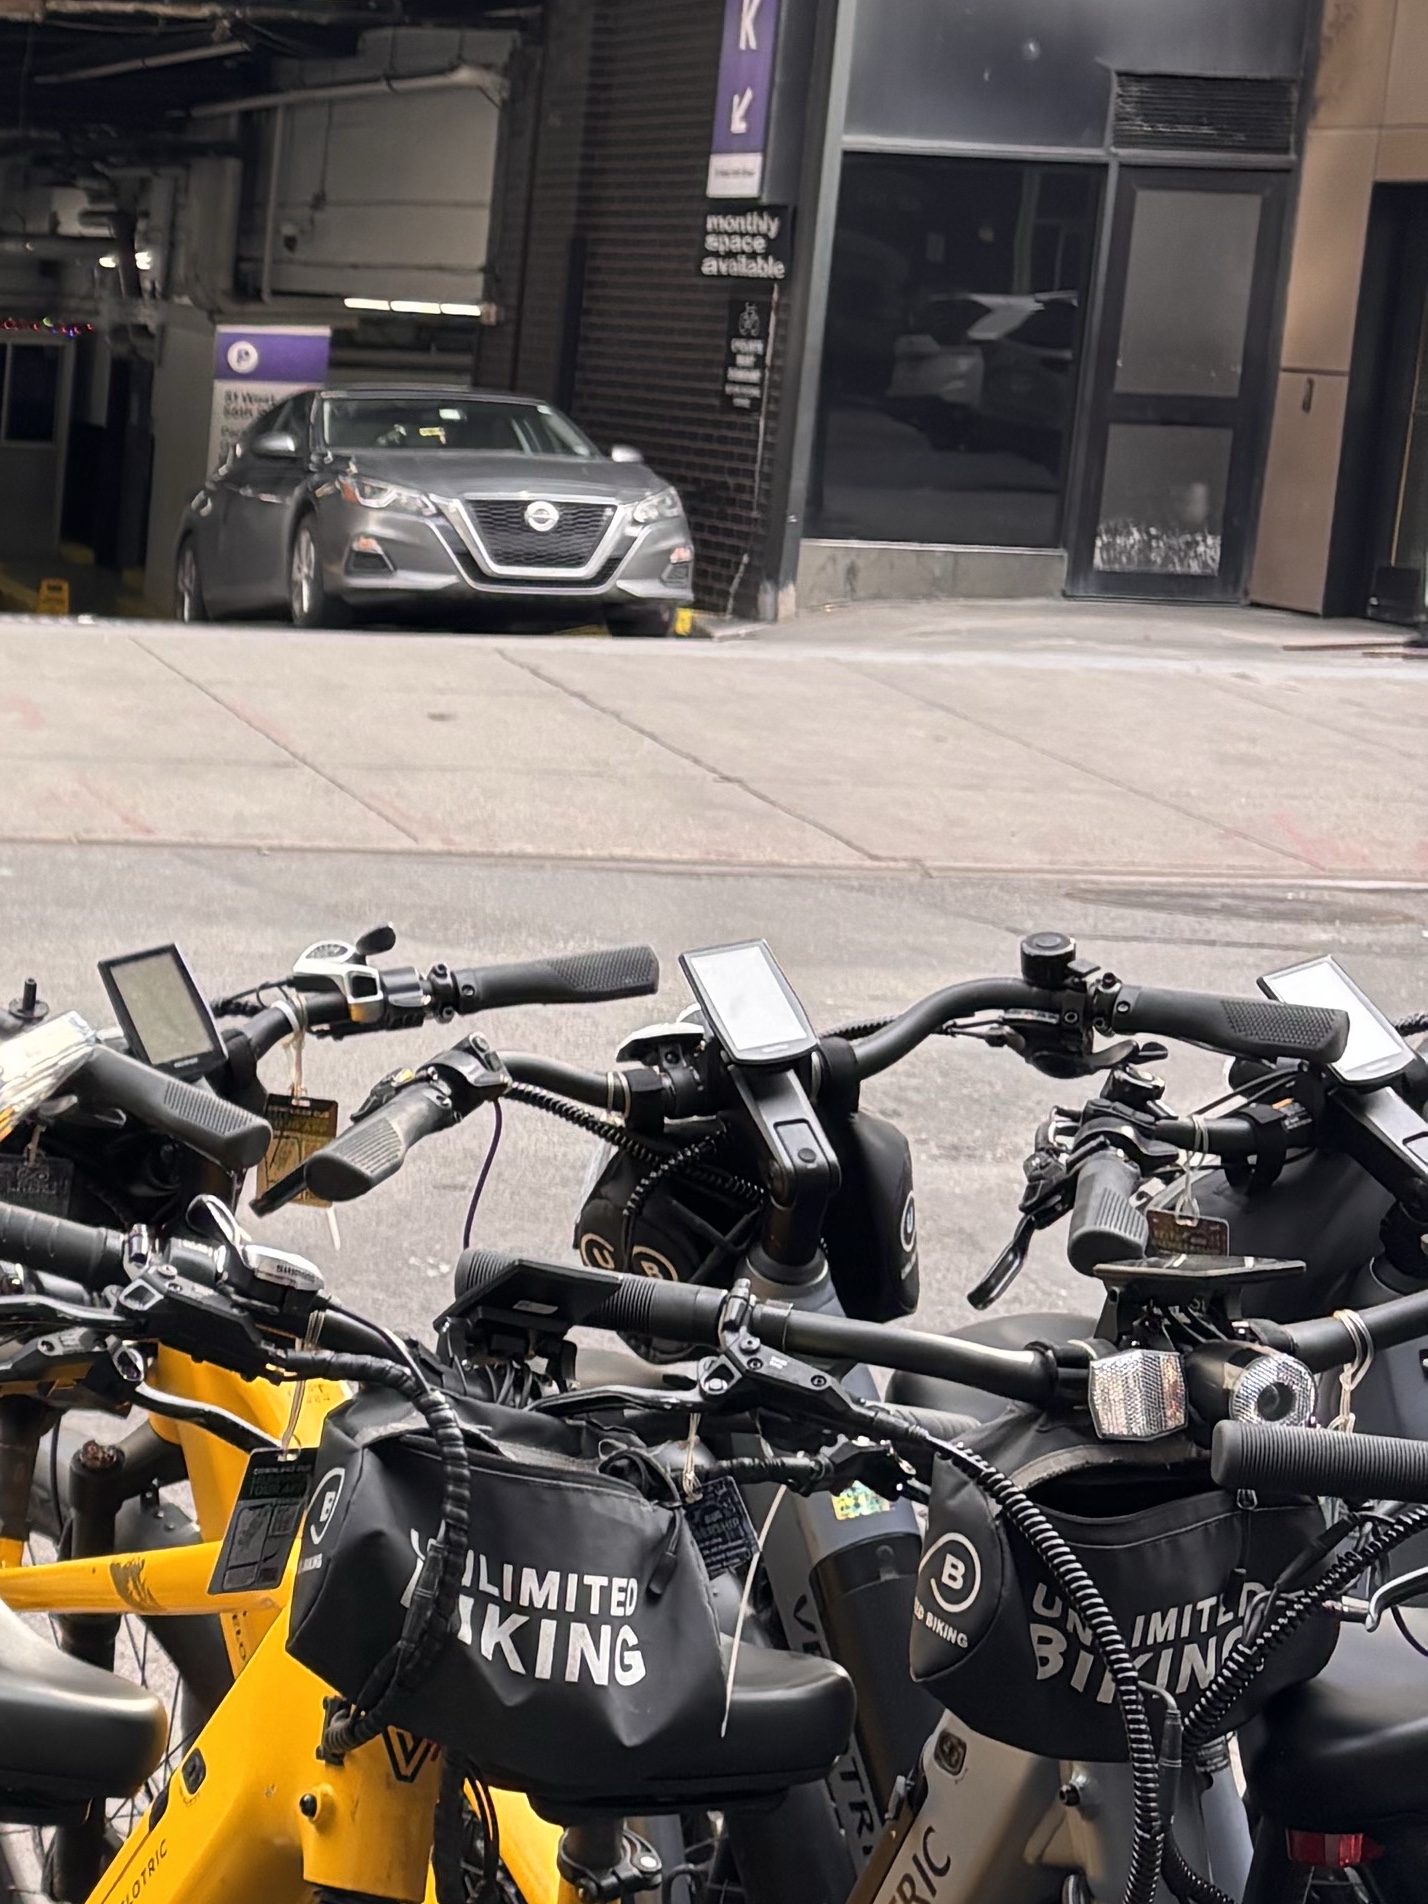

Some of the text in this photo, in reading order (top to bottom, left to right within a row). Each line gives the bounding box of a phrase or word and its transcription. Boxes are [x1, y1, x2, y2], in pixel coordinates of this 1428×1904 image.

[706, 211, 780, 239] monthly
[704, 233, 767, 255] space
[701, 254, 786, 279] available
[410, 1519, 638, 1618] ULIMITED
[941, 1553, 967, 1590] B
[401, 1556, 646, 1687] IKING
[925, 1611, 969, 1649] BIKING
[1032, 1581, 1271, 1648] UNIMITED
